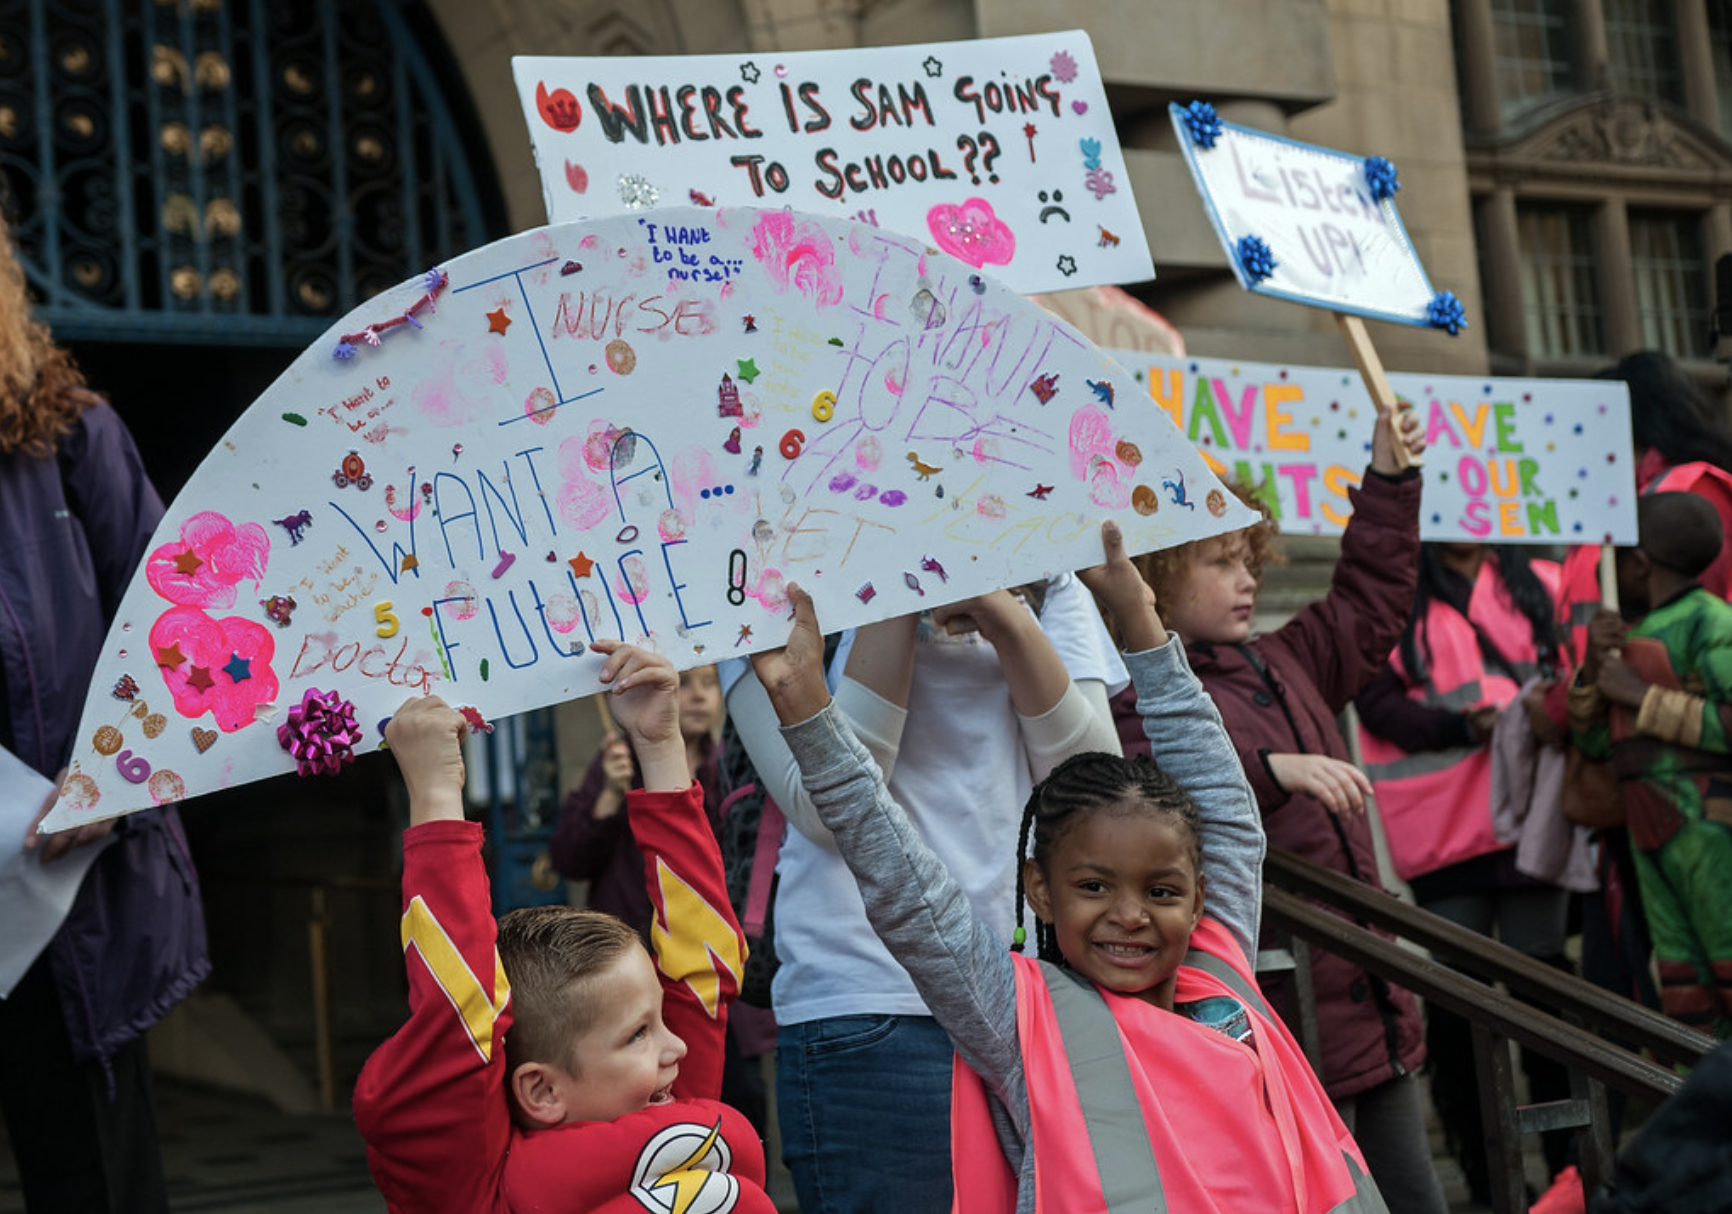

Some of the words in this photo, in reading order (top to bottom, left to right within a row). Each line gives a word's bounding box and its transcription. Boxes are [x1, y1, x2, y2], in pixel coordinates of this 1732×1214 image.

[586, 82, 763, 146] WHERE
[779, 82, 831, 134] IS
[850, 78, 935, 132] SAM
[730, 154, 790, 198] TO
[652, 245, 673, 263] to
[678, 246, 700, 266] be
[452, 257, 605, 427] I
[375, 376, 391, 391] to
[346, 419, 367, 433] be
[811, 390, 837, 424] 6
[1148, 366, 1311, 452] HAVE
[1393, 393, 1525, 454] AVE
[779, 428, 806, 460] 6
[1456, 455, 1544, 499] OUR
[328, 446, 558, 585] WANT
[608, 430, 675, 524] A
[1458, 498, 1562, 539] SEN
[374, 601, 400, 638] 5
[116, 749, 151, 785] 6
